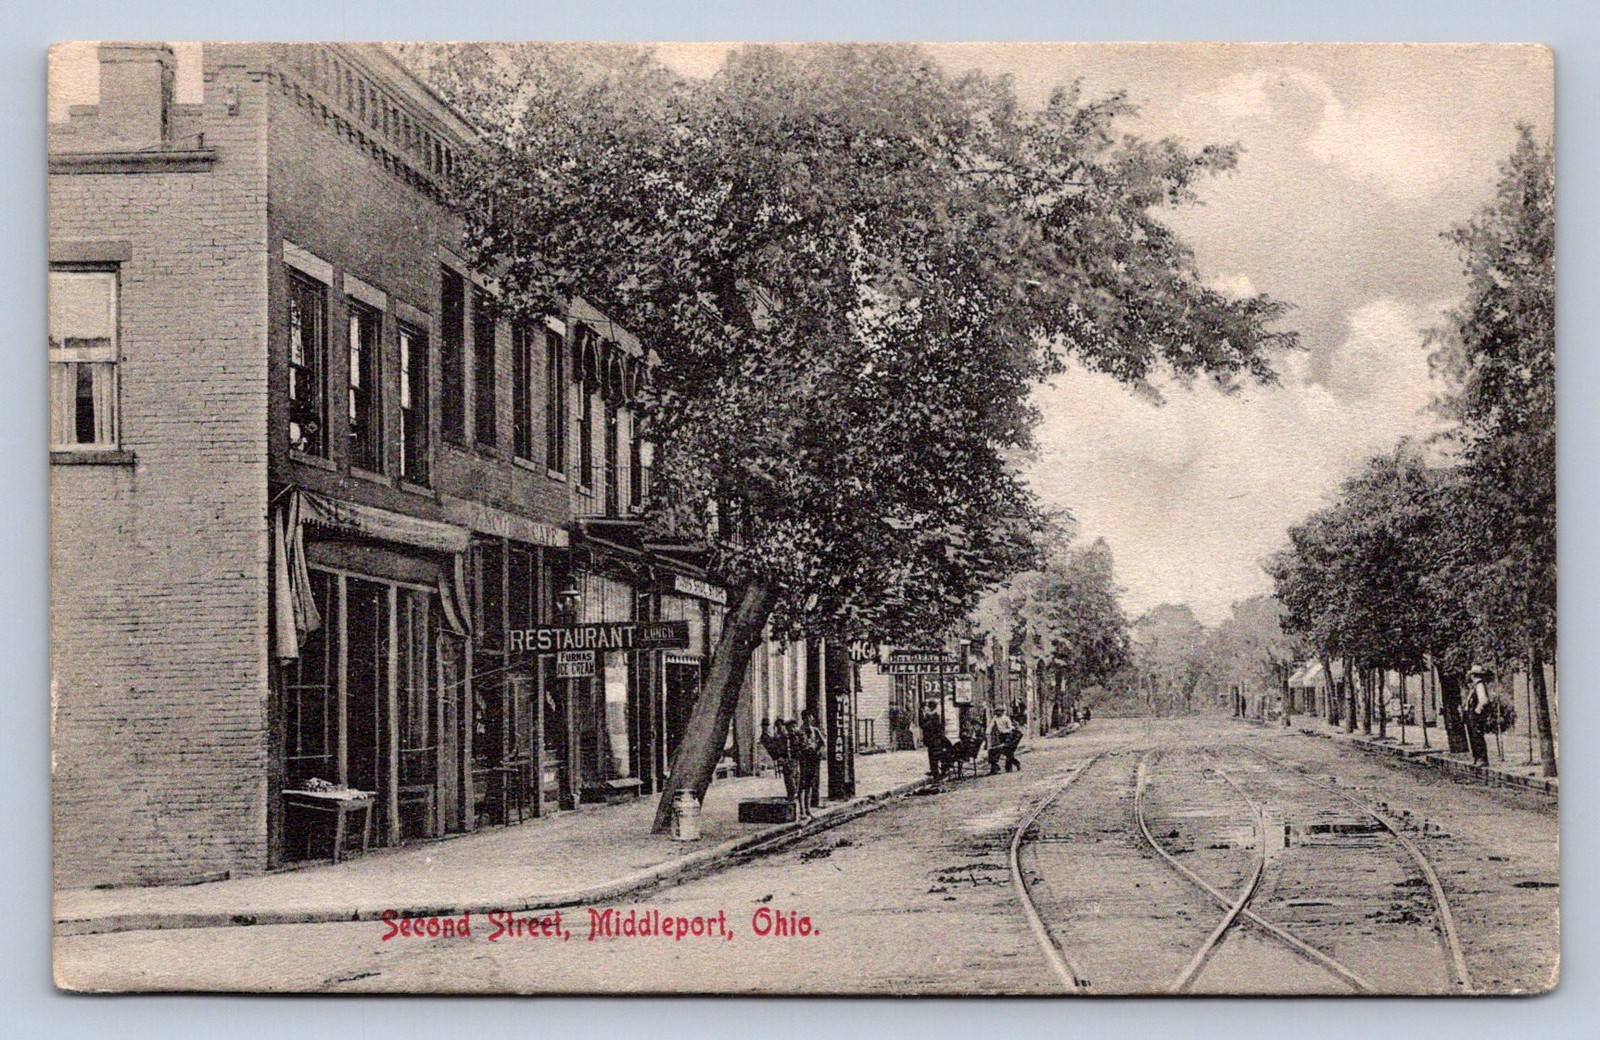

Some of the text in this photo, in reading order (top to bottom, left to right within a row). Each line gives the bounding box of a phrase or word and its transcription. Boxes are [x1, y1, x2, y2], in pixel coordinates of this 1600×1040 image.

[510, 626, 636, 650] RESTAURANT
[643, 627, 674, 640] LUNCH
[557, 662, 595, 677] ICE CREAM
[835, 694, 844, 761] WILLIAMS
